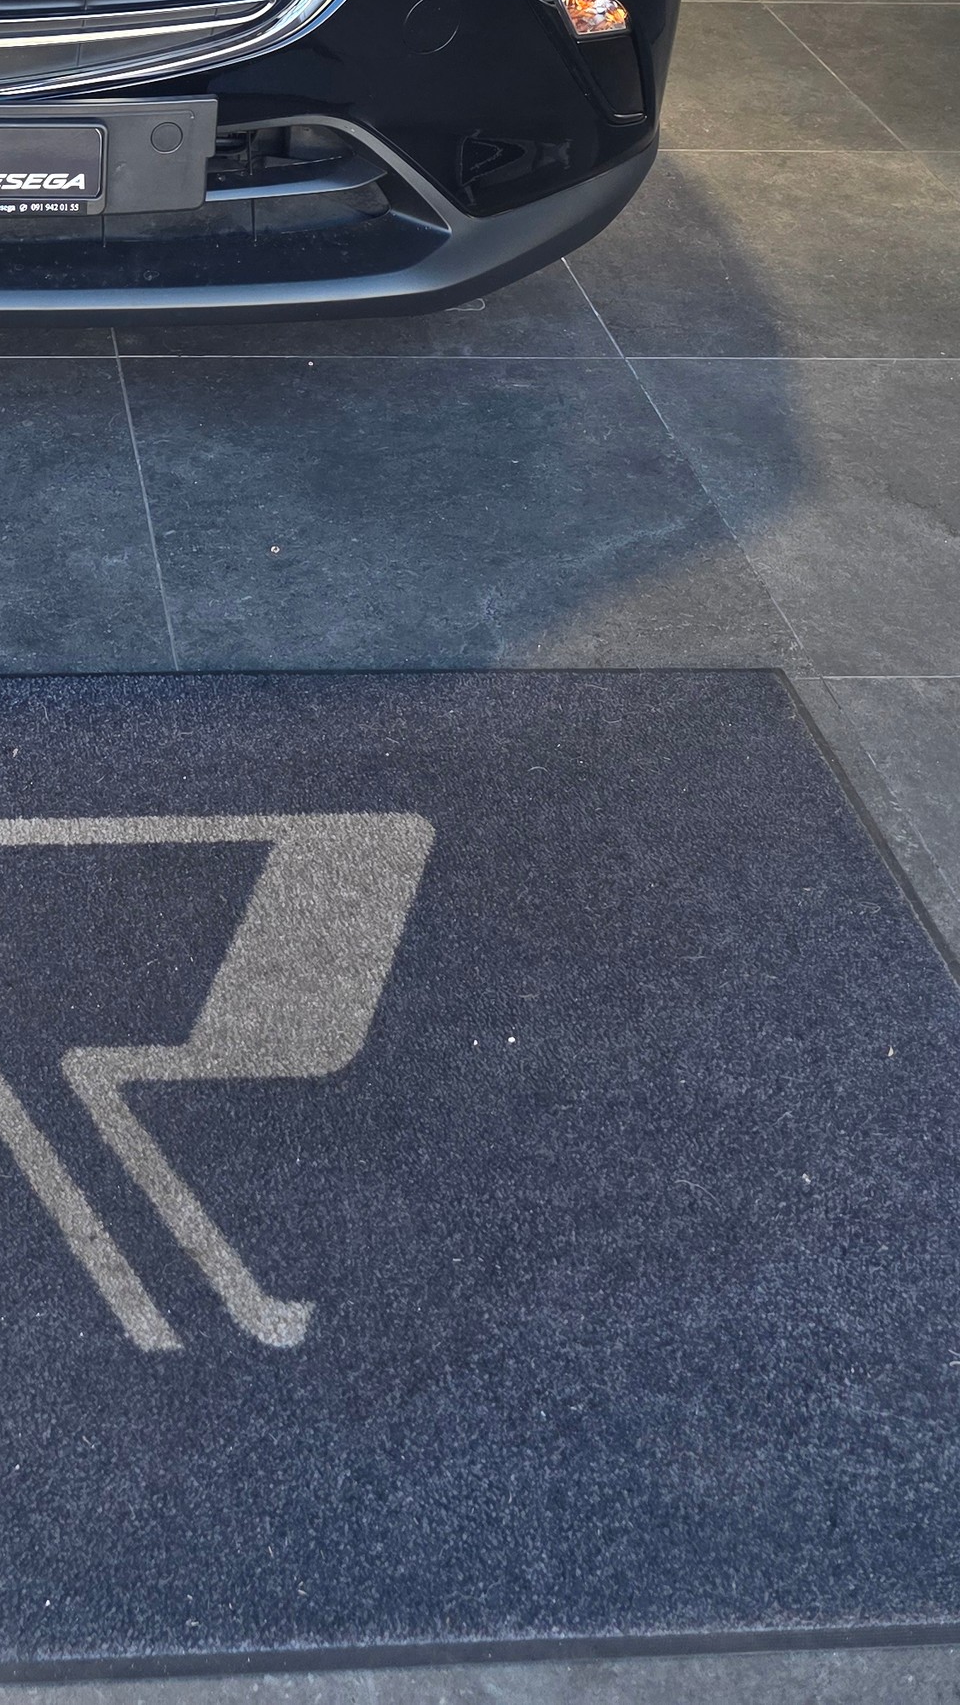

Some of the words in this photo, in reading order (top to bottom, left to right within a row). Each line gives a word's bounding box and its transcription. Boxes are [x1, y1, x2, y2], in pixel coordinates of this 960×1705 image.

[30, 203, 44, 212] 091
[45, 203, 59, 212] 942
[60, 203, 68, 212] 01
